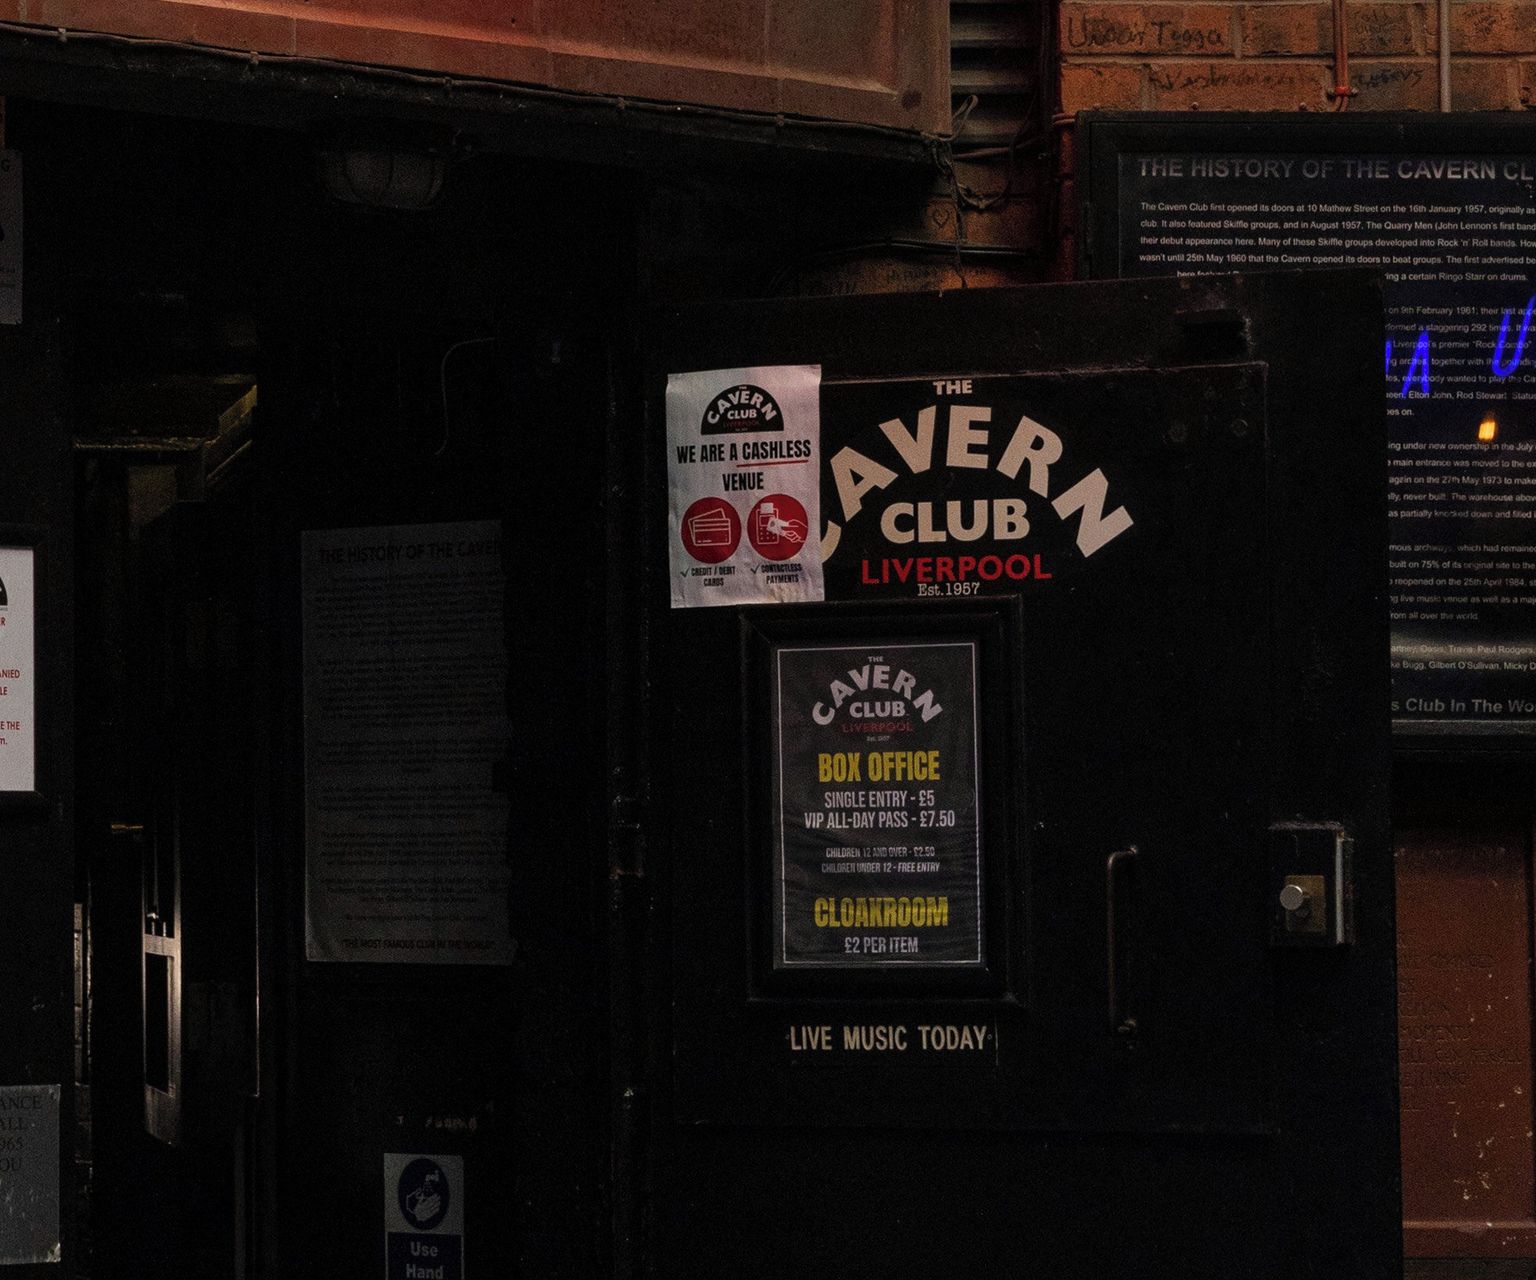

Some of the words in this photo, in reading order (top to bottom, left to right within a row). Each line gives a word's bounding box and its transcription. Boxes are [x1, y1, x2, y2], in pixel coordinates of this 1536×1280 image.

[1139, 158, 1183, 178] THE
[1191, 158, 1296, 178] HISTORY
[1302, 158, 1334, 179] OF
[1342, 159, 1389, 179] THE
[1397, 160, 1496, 180] CAVERN
[1141, 202, 1156, 211] The
[1158, 203, 1187, 212] Cavern
[1189, 203, 1208, 212] Club
[1210, 203, 1225, 212] first
[1227, 203, 1258, 214] opened
[1259, 204, 1270, 213] its
[1271, 204, 1294, 213] doors
[1296, 205, 1305, 213] at
[1308, 204, 1318, 213] 10
[1319, 204, 1352, 213] Mathew
[1353, 204, 1378, 213] Street
[1393, 205, 1406, 213] the
[1409, 204, 1427, 213] 16th
[1429, 205, 1462, 214] January
[1489, 205, 1524, 215] originally
[1171, 220, 1186, 228] also
[1188, 220, 1221, 229] featured
[1223, 220, 1248, 229] Skiffle
[1310, 221, 1339, 231] August
[1384, 222, 1413, 231] Quarry
[1435, 222, 1458, 231] (John
[1460, 222, 1497, 230] Lennon's
[1499, 222, 1515, 230] first
[933, 379, 972, 395] THE
[707, 391, 777, 424] CAVERN
[727, 408, 757, 419] CLUB
[677, 445, 696, 464] WE
[700, 443, 725, 463] ARE
[729, 442, 738, 461] A
[742, 439, 811, 461] CASHLESS
[722, 472, 764, 491] VENUE
[880, 498, 1031, 544] CLUB
[862, 554, 1053, 584] LIVERPOOL
[703, 577, 724, 587] CARDS
[766, 573, 800, 585] PAYMENTS
[917, 582, 980, 596] Est.1957
[812, 664, 943, 726] CAVERN
[849, 701, 906, 718] CLUB
[1405, 698, 1445, 711] Club
[1451, 699, 1465, 711] In
[1472, 699, 1503, 713] The
[6, 721, 20, 730] THE
[842, 721, 913, 733] LIVERPOOL
[818, 752, 862, 783] BOX
[868, 750, 941, 782] OFFICE
[824, 791, 866, 808] SINGLE
[868, 791, 908, 807] ENTRY
[918, 790, 935, 807] £5
[804, 812, 824, 829] VIP
[826, 812, 876, 828] ALL-DAY
[878, 811, 908, 828] PASS
[919, 810, 956, 827] £7.50
[825, 847, 861, 858] CHILDREN
[872, 847, 887, 858] AND
[888, 847, 908, 858] OVER
[913, 846, 936, 857] £2.50
[821, 863, 856, 873] CHILDREN
[857, 863, 881, 873] UNDER
[882, 863, 892, 873] 12
[897, 862, 916, 873] FREE
[917, 862, 940, 872] ENTRY
[814, 896, 949, 928] CLOAKROOM
[844, 937, 860, 954] £2
[863, 937, 887, 953] PER
[889, 936, 919, 953] ITEM
[790, 1026, 833, 1051] LIVE
[843, 1026, 909, 1051] MUSIC
[917, 1025, 988, 1051] TODAY
[409, 1241, 439, 1257] Use
[405, 1263, 444, 1280] Hand
